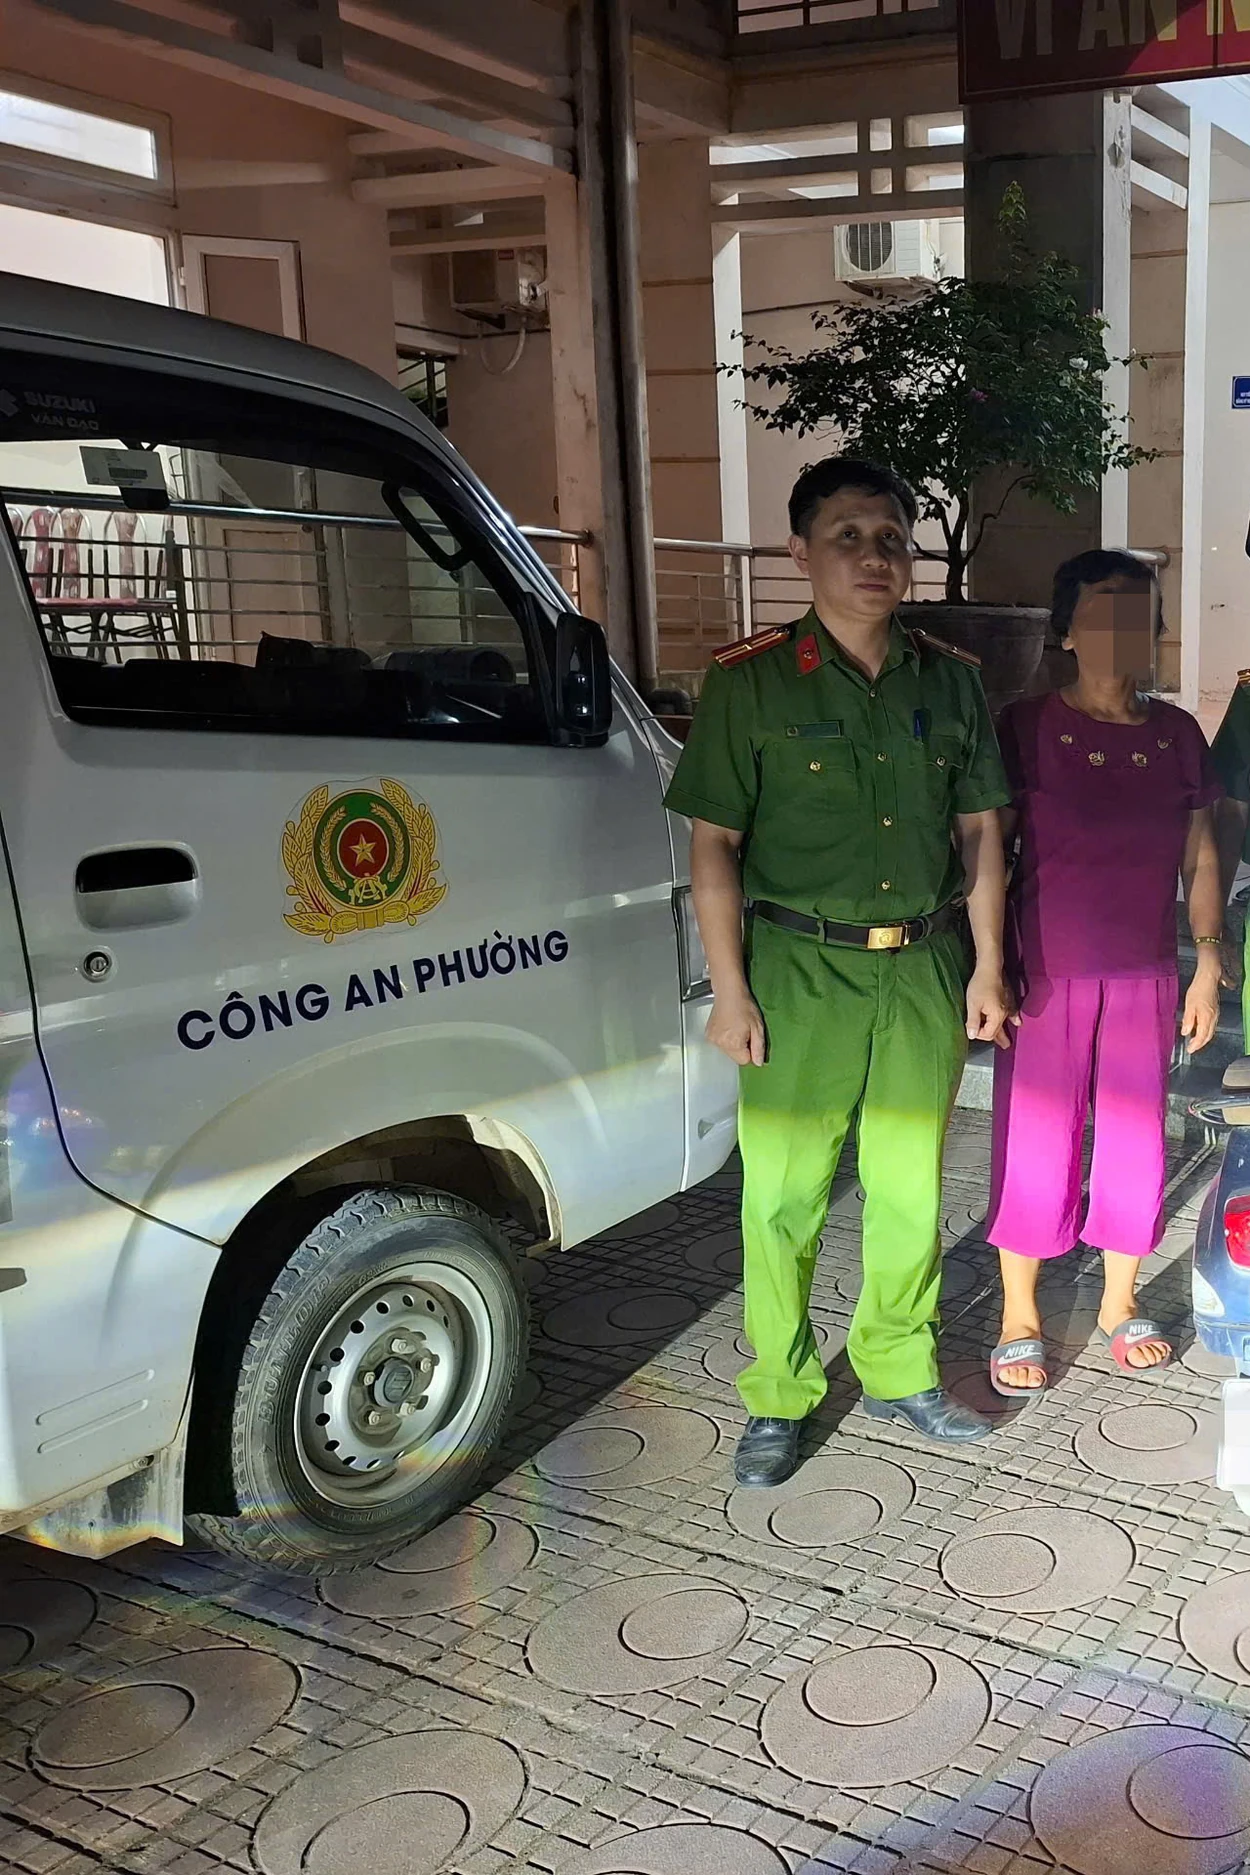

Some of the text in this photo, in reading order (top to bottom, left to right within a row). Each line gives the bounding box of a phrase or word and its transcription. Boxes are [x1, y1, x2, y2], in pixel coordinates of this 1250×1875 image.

[23, 391, 96, 414] SUZUKI
[177, 929, 570, 1051] CÔNG AN PHƯỜNG
[1128, 1324, 1154, 1336] NIKE
[1004, 1344, 1035, 1358] NIKE
